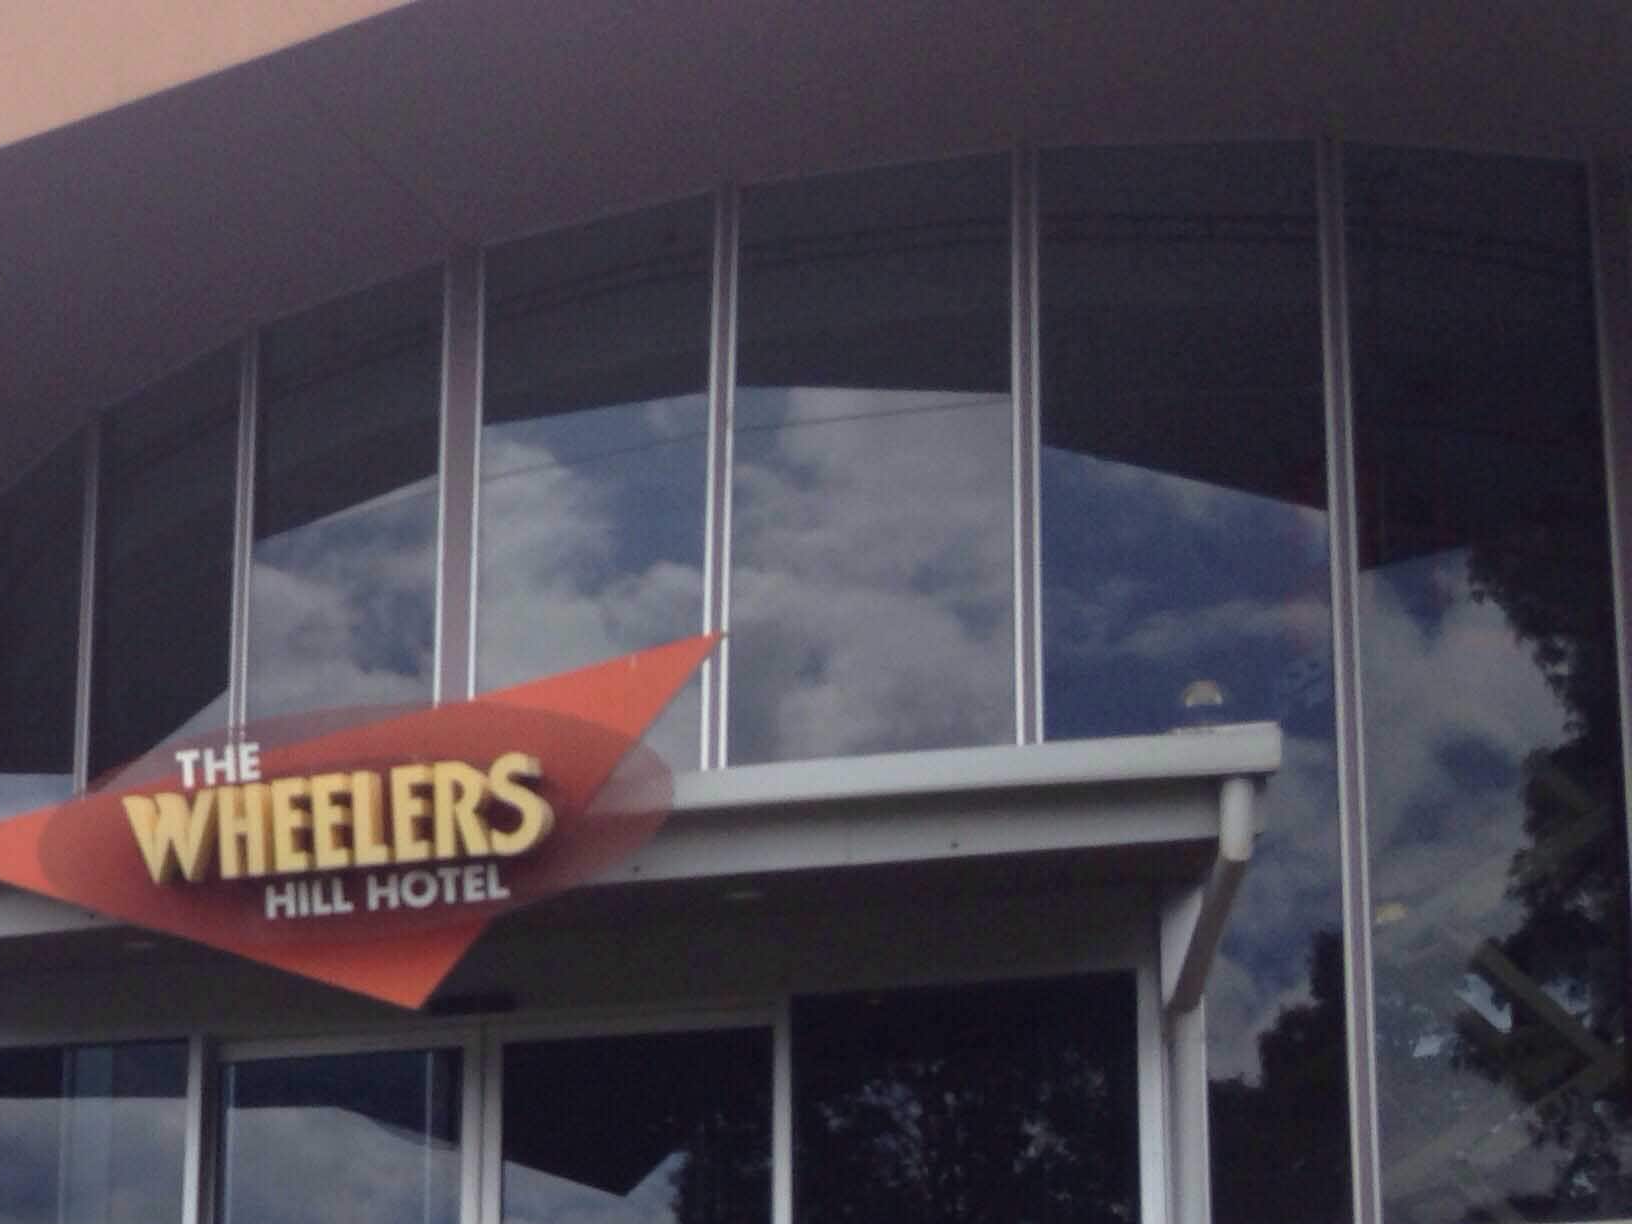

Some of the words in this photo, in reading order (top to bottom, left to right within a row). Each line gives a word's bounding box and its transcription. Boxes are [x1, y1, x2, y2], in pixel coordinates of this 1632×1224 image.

[175, 742, 260, 788] THE
[123, 752, 555, 885] WHEELERS
[265, 876, 354, 920] HILL
[368, 862, 510, 911] HOTEL
